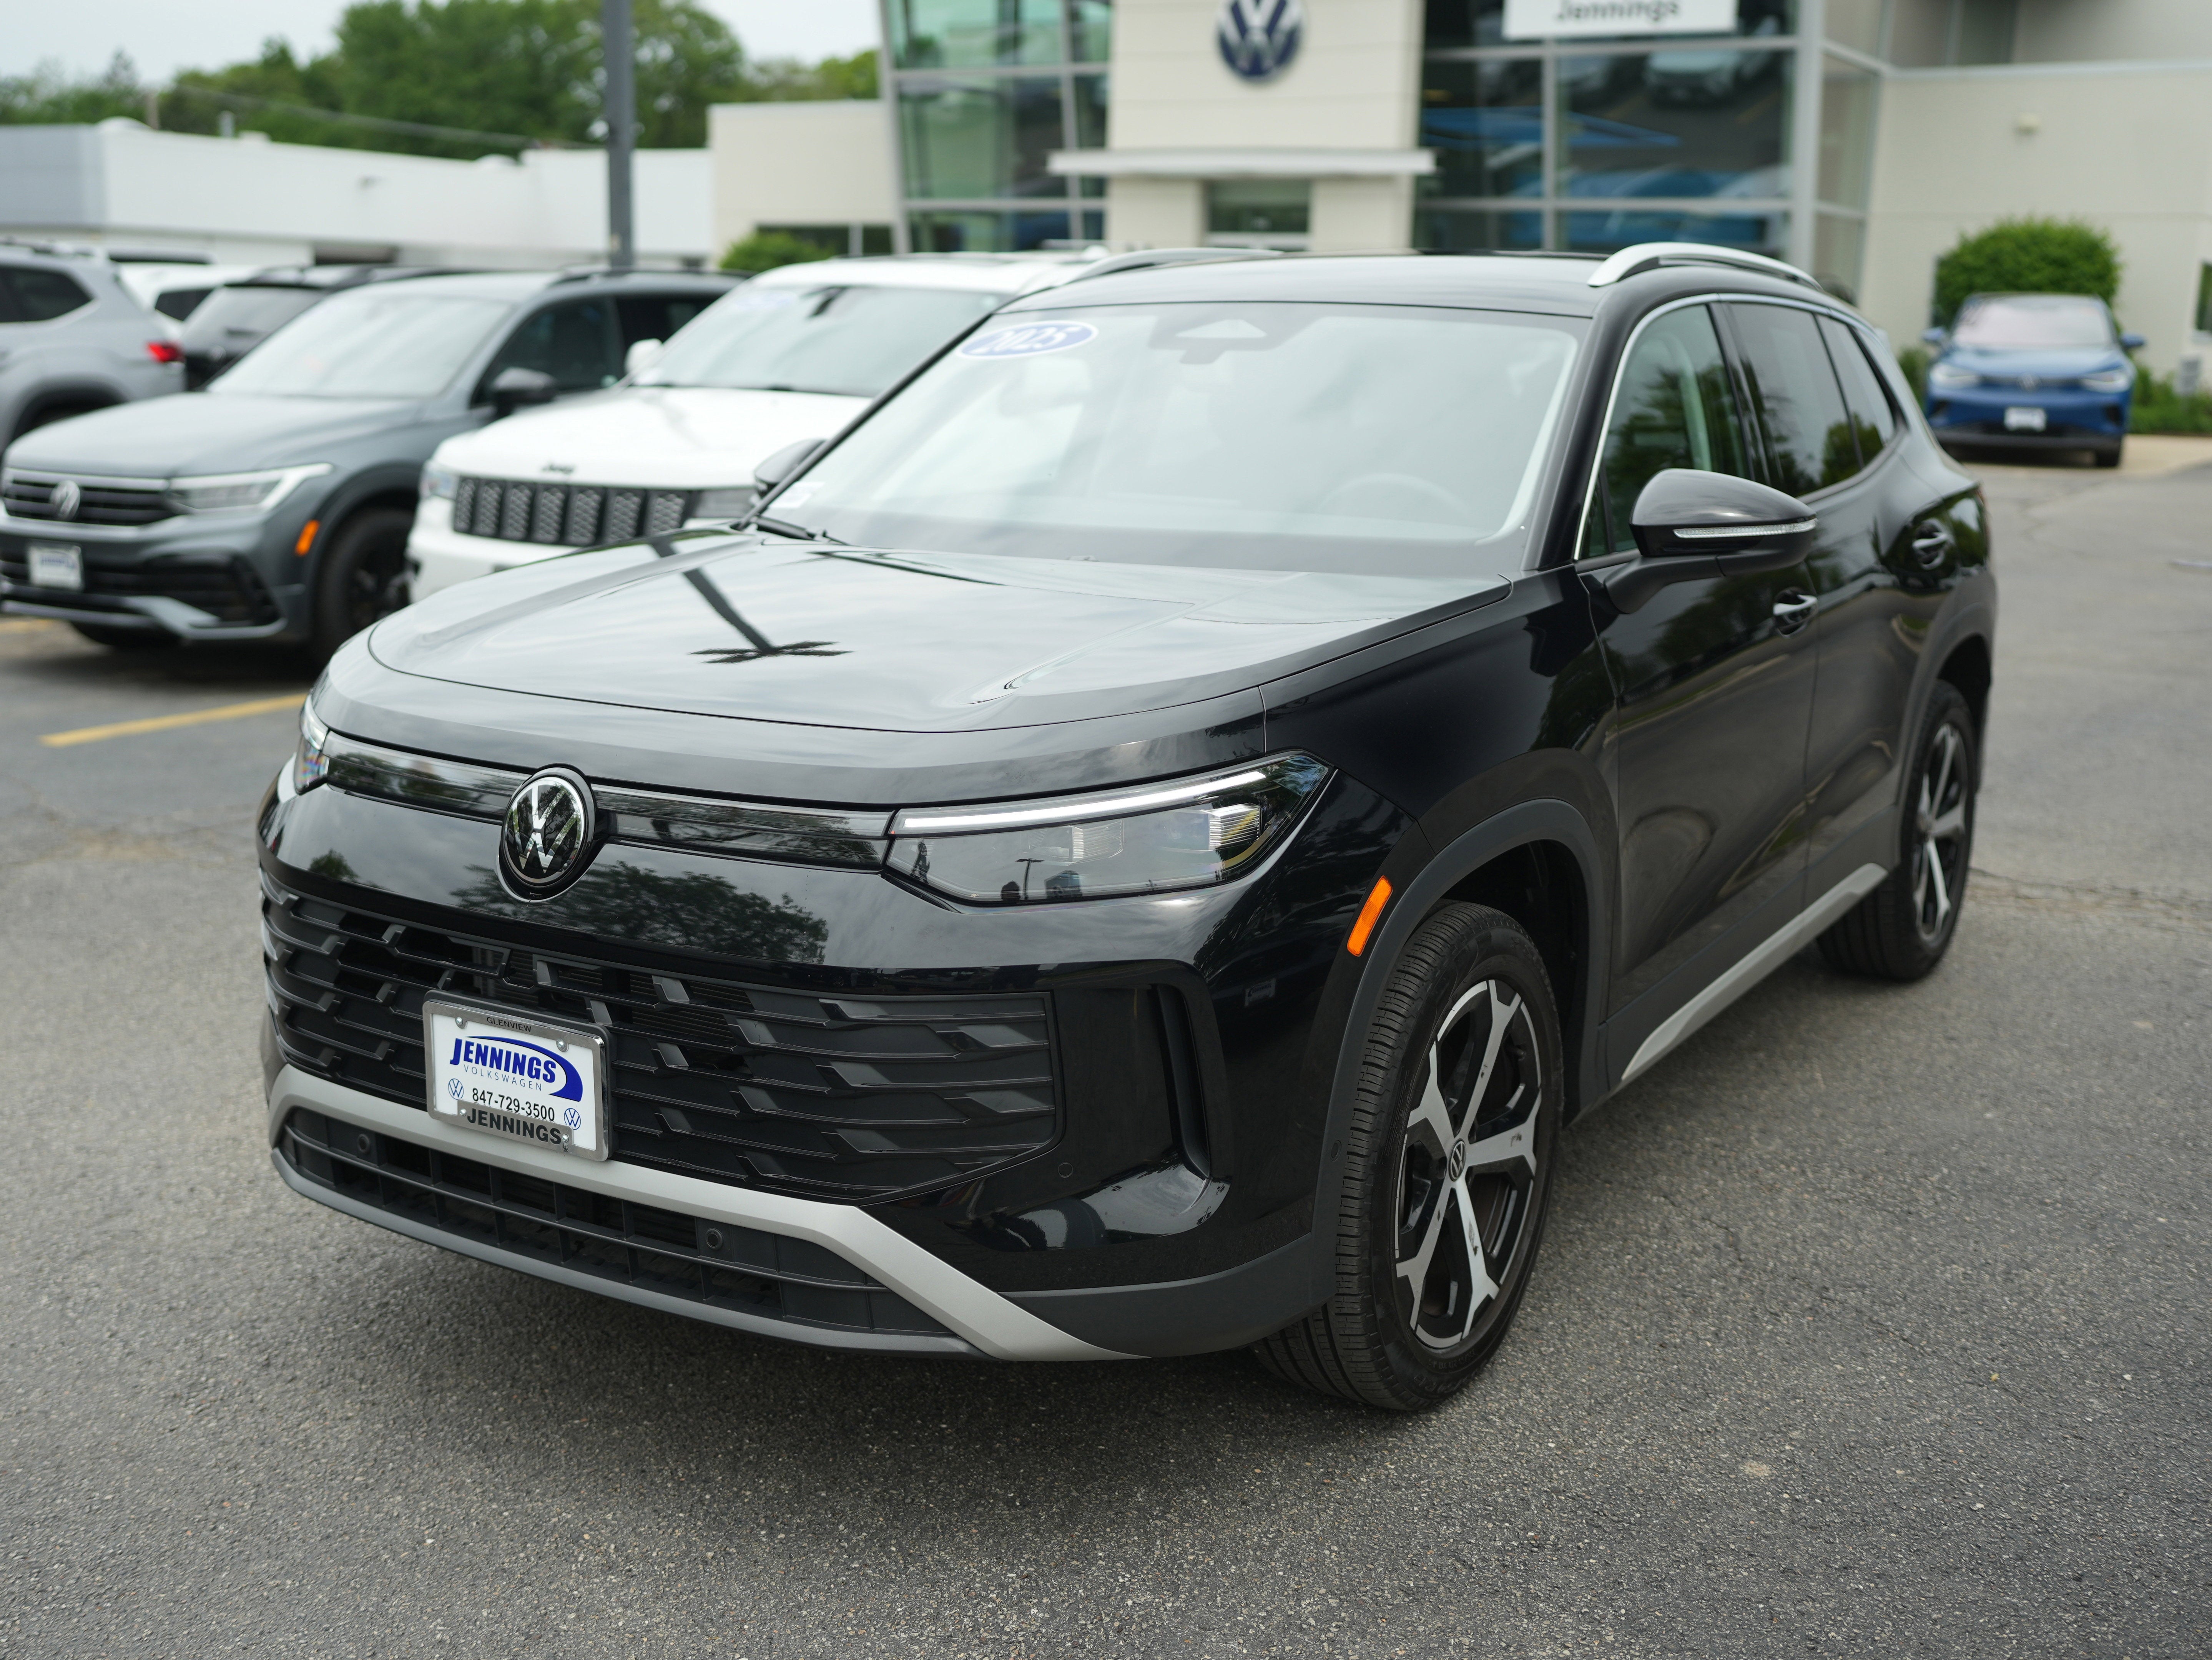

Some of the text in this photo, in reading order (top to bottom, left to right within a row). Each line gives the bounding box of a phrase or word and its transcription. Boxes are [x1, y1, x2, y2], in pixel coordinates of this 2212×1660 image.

[969, 326, 1082, 354] 2025
[486, 1016, 532, 1033] GLENVIEW
[449, 1038, 557, 1083] JENNINGS
[463, 1064, 542, 1091] VOLKSWAGEN
[472, 1087, 555, 1122] 847-729-3500
[467, 1108, 562, 1145] JENNINGS
